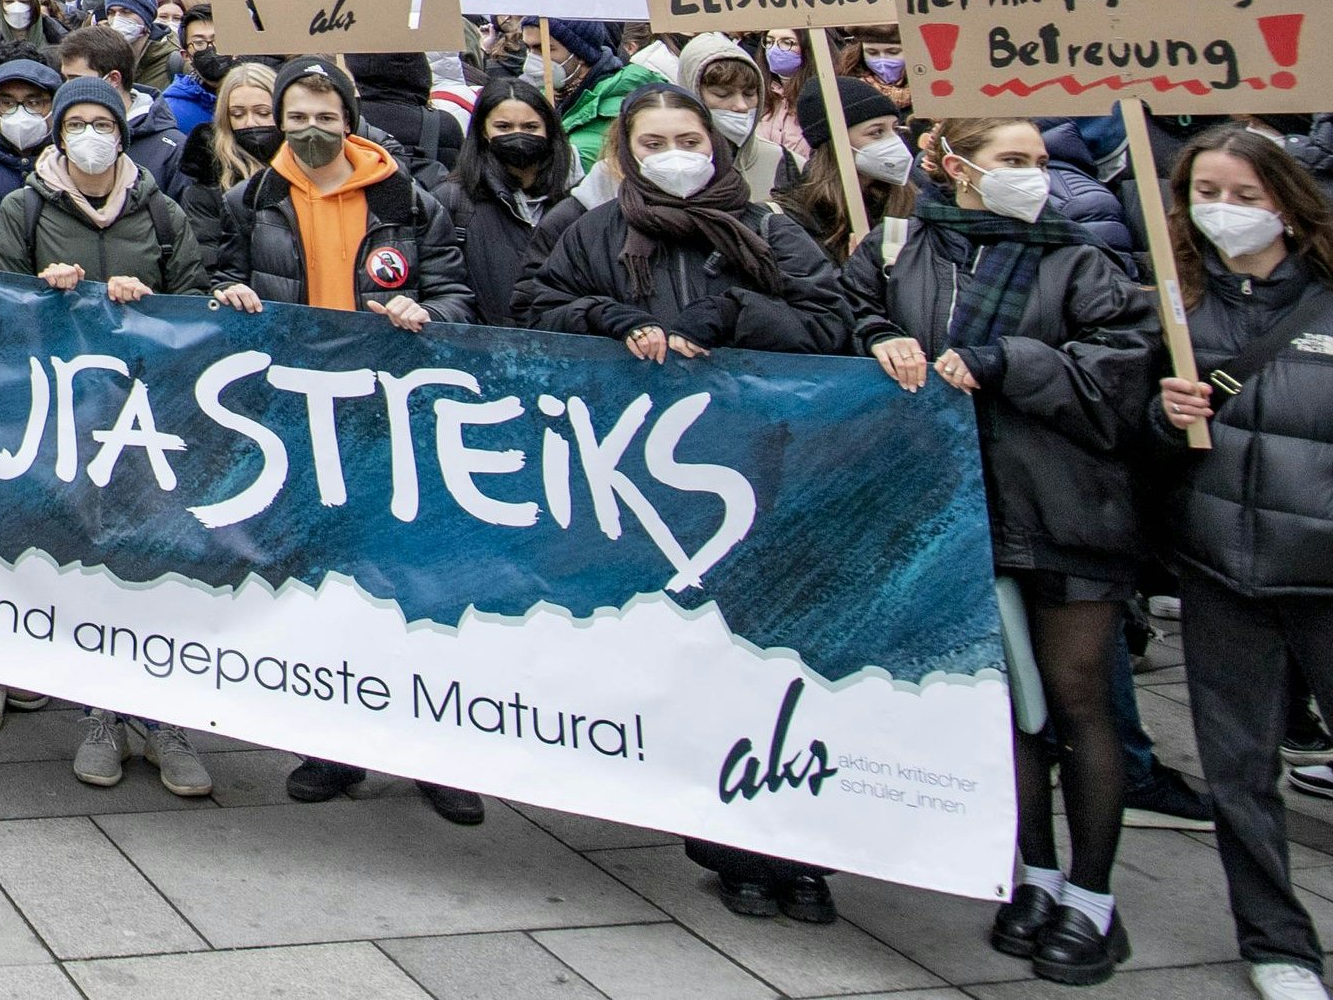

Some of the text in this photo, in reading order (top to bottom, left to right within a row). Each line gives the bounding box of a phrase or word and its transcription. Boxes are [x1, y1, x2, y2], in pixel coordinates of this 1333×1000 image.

[989, 22, 1240, 90] Betreuung
[73, 620, 391, 711] angepasste
[413, 673, 646, 762] Matura!
[838, 752, 979, 793] aktion kritischer
[840, 778, 967, 815] schüler_innen
